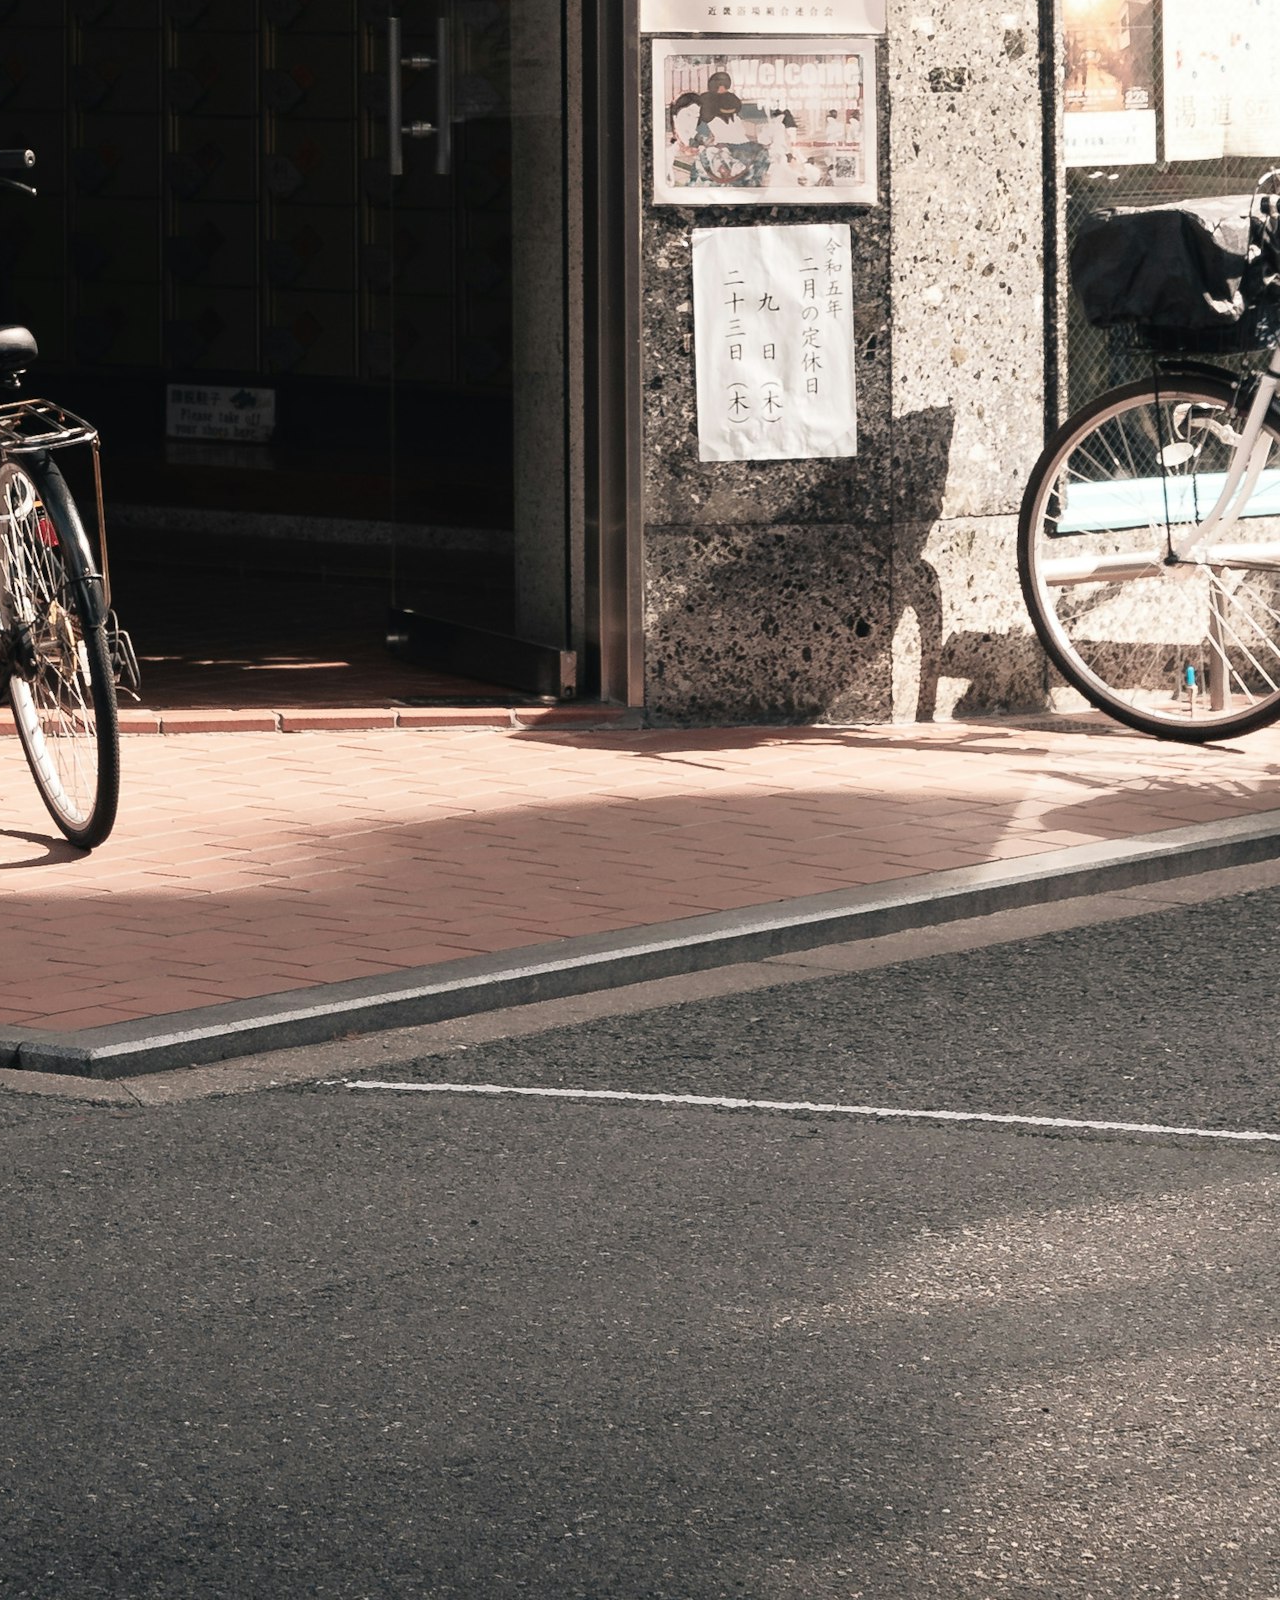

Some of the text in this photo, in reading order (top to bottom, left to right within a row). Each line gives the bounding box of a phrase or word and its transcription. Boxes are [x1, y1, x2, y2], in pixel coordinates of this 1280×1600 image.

[730, 58, 861, 86] Welcome
[823, 237, 844, 319] 令和五年
[798, 256, 824, 396] 二月の定休日
